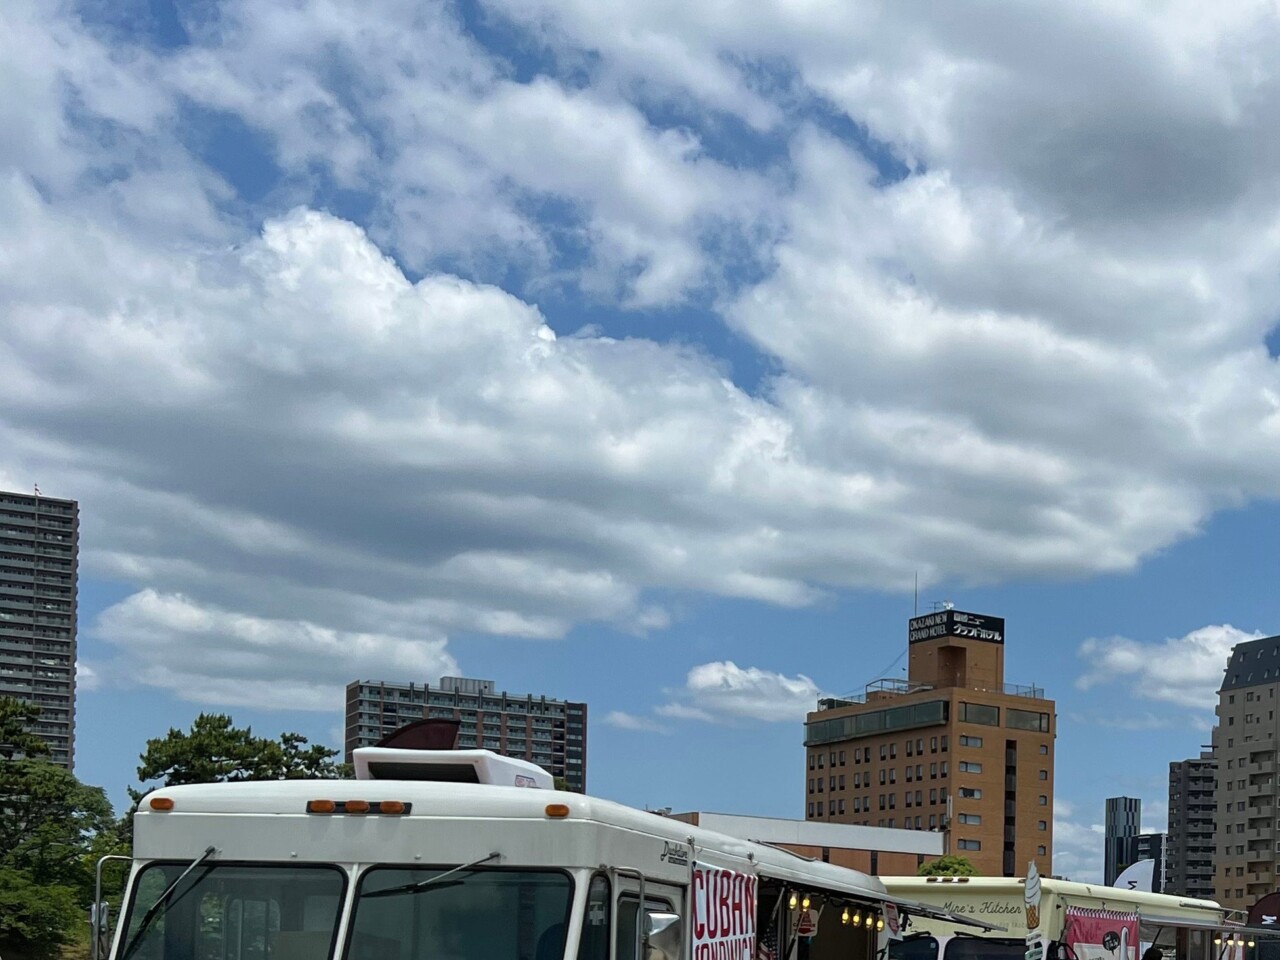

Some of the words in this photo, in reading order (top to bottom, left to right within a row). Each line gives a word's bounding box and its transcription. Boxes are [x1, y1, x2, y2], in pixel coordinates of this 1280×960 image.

[910, 628, 929, 641] GRAND
[929, 624, 948, 637] HOTEL
[953, 623, 1002, 641] グランドホテル
[693, 869, 757, 940] CUBAN
[943, 901, 975, 914] Mine's
[978, 901, 1022, 914] Kitchen
